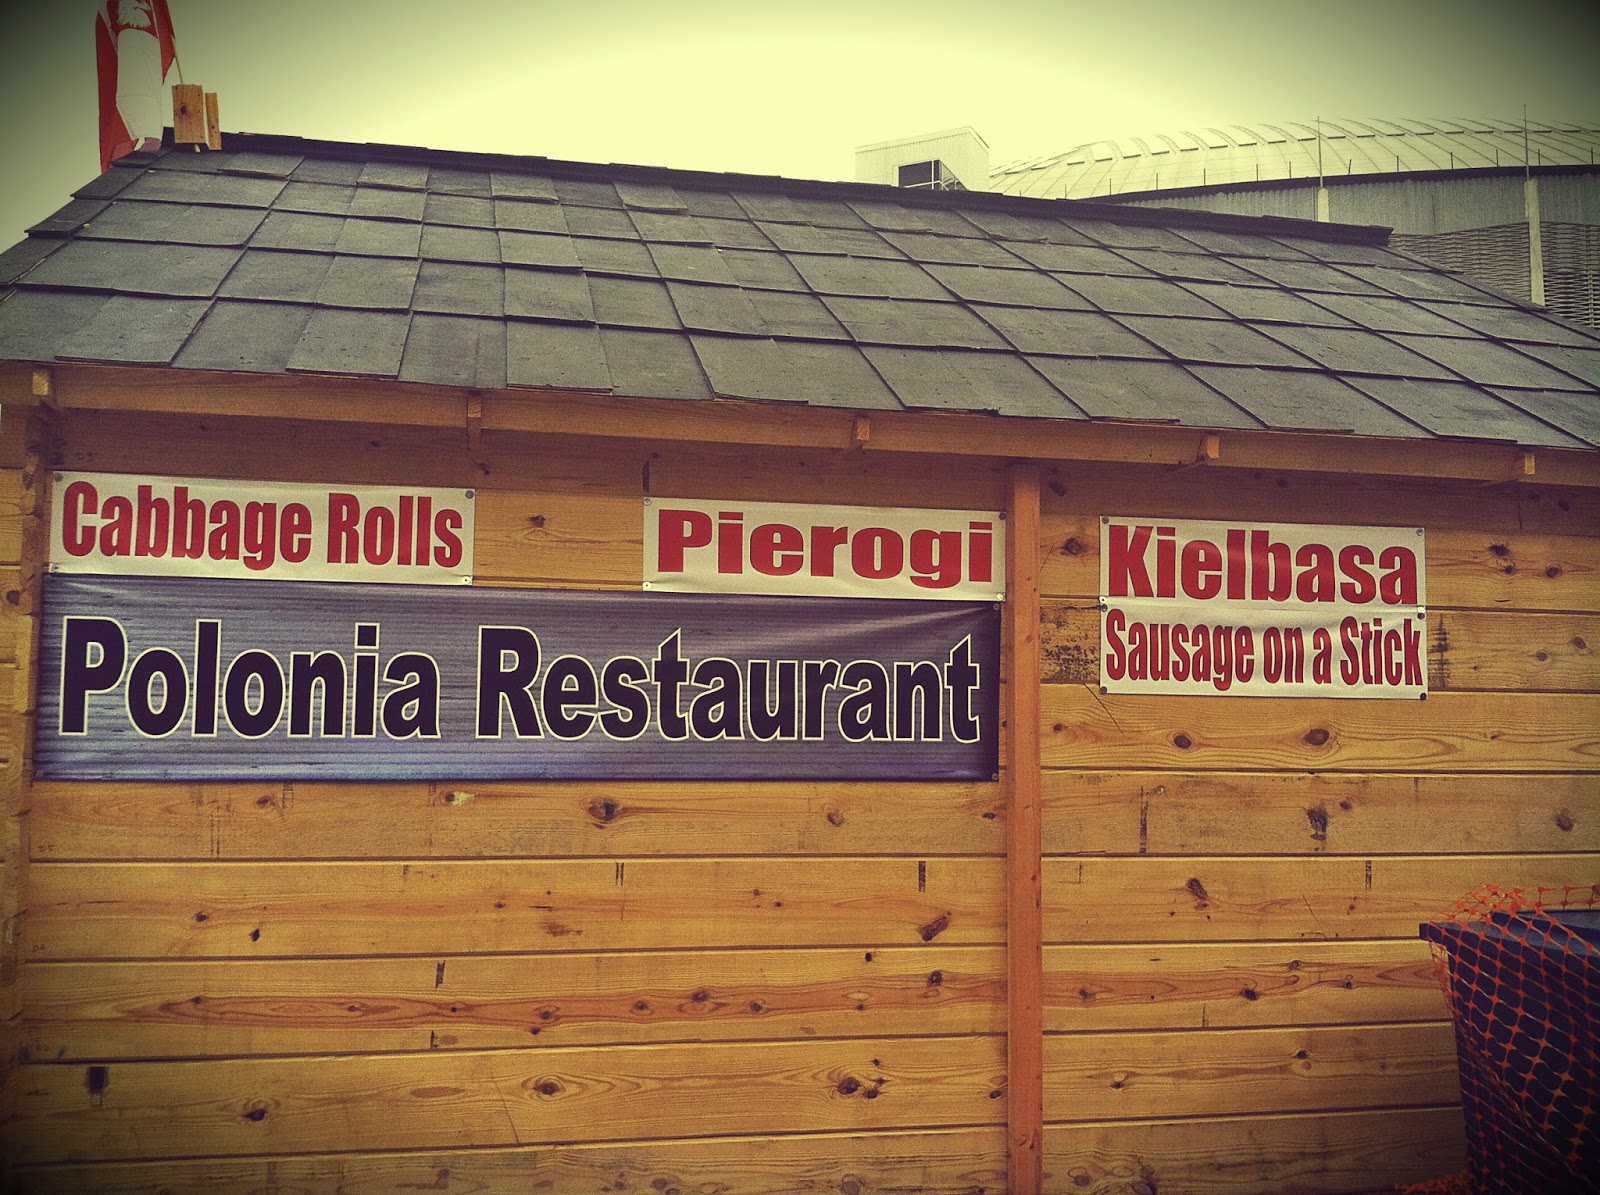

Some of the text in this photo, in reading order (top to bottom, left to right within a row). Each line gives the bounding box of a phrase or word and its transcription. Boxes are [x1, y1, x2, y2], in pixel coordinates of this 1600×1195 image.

[62, 481, 463, 570] Cabbage Rolls
[657, 508, 993, 588] Pierogi
[1108, 524, 1418, 605] Kielbasa
[58, 615, 981, 743] Polonia Restaurant
[1105, 608, 1424, 691] Sausage on a Stick
